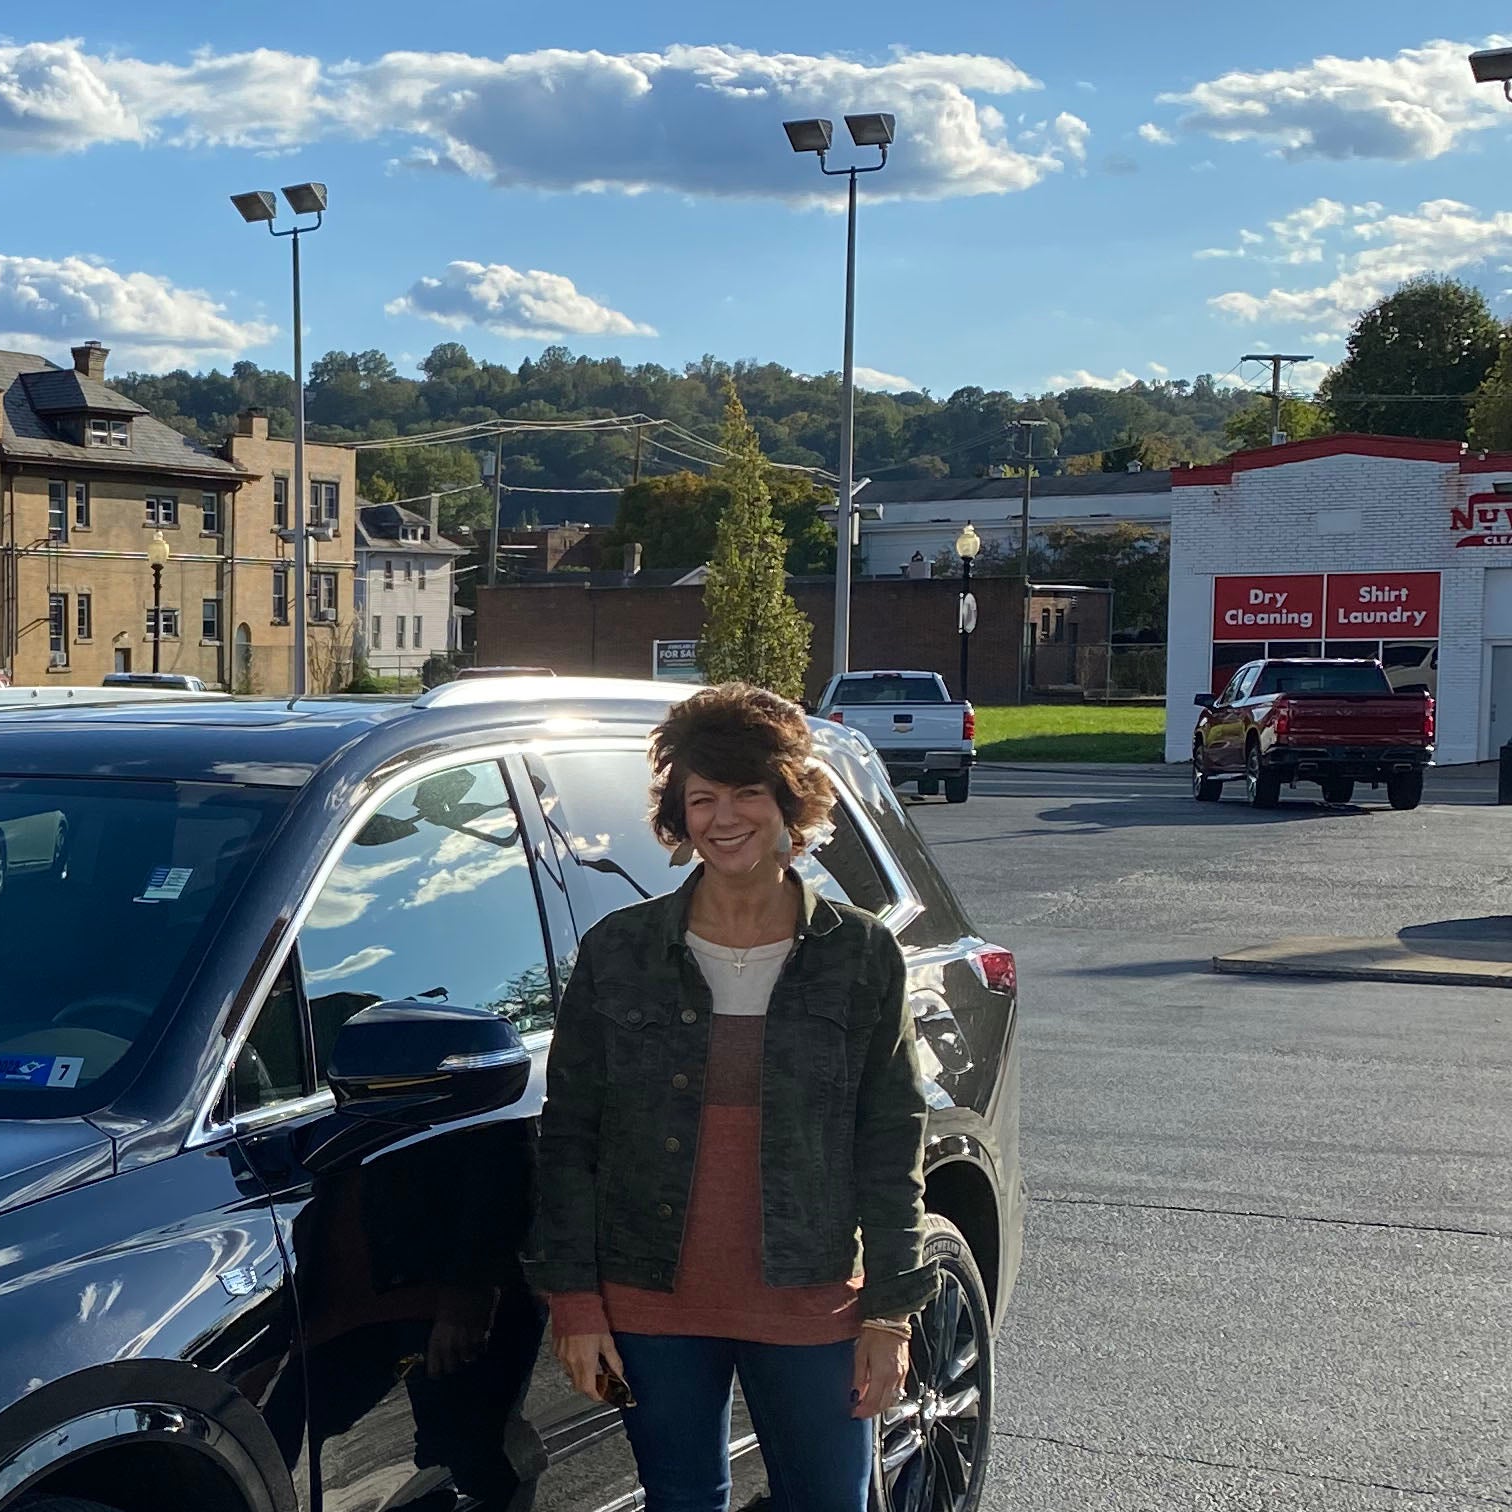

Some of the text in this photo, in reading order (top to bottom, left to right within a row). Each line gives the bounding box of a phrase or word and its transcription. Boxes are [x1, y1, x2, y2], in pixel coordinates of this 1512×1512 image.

[1249, 588, 1288, 608] Dry
[1359, 585, 1409, 603] Shirt
[1224, 608, 1313, 628] Cleaning
[1338, 606, 1427, 627] Laundry
[659, 649, 697, 659] FOR SAL
[58, 1064, 71, 1081] 7
